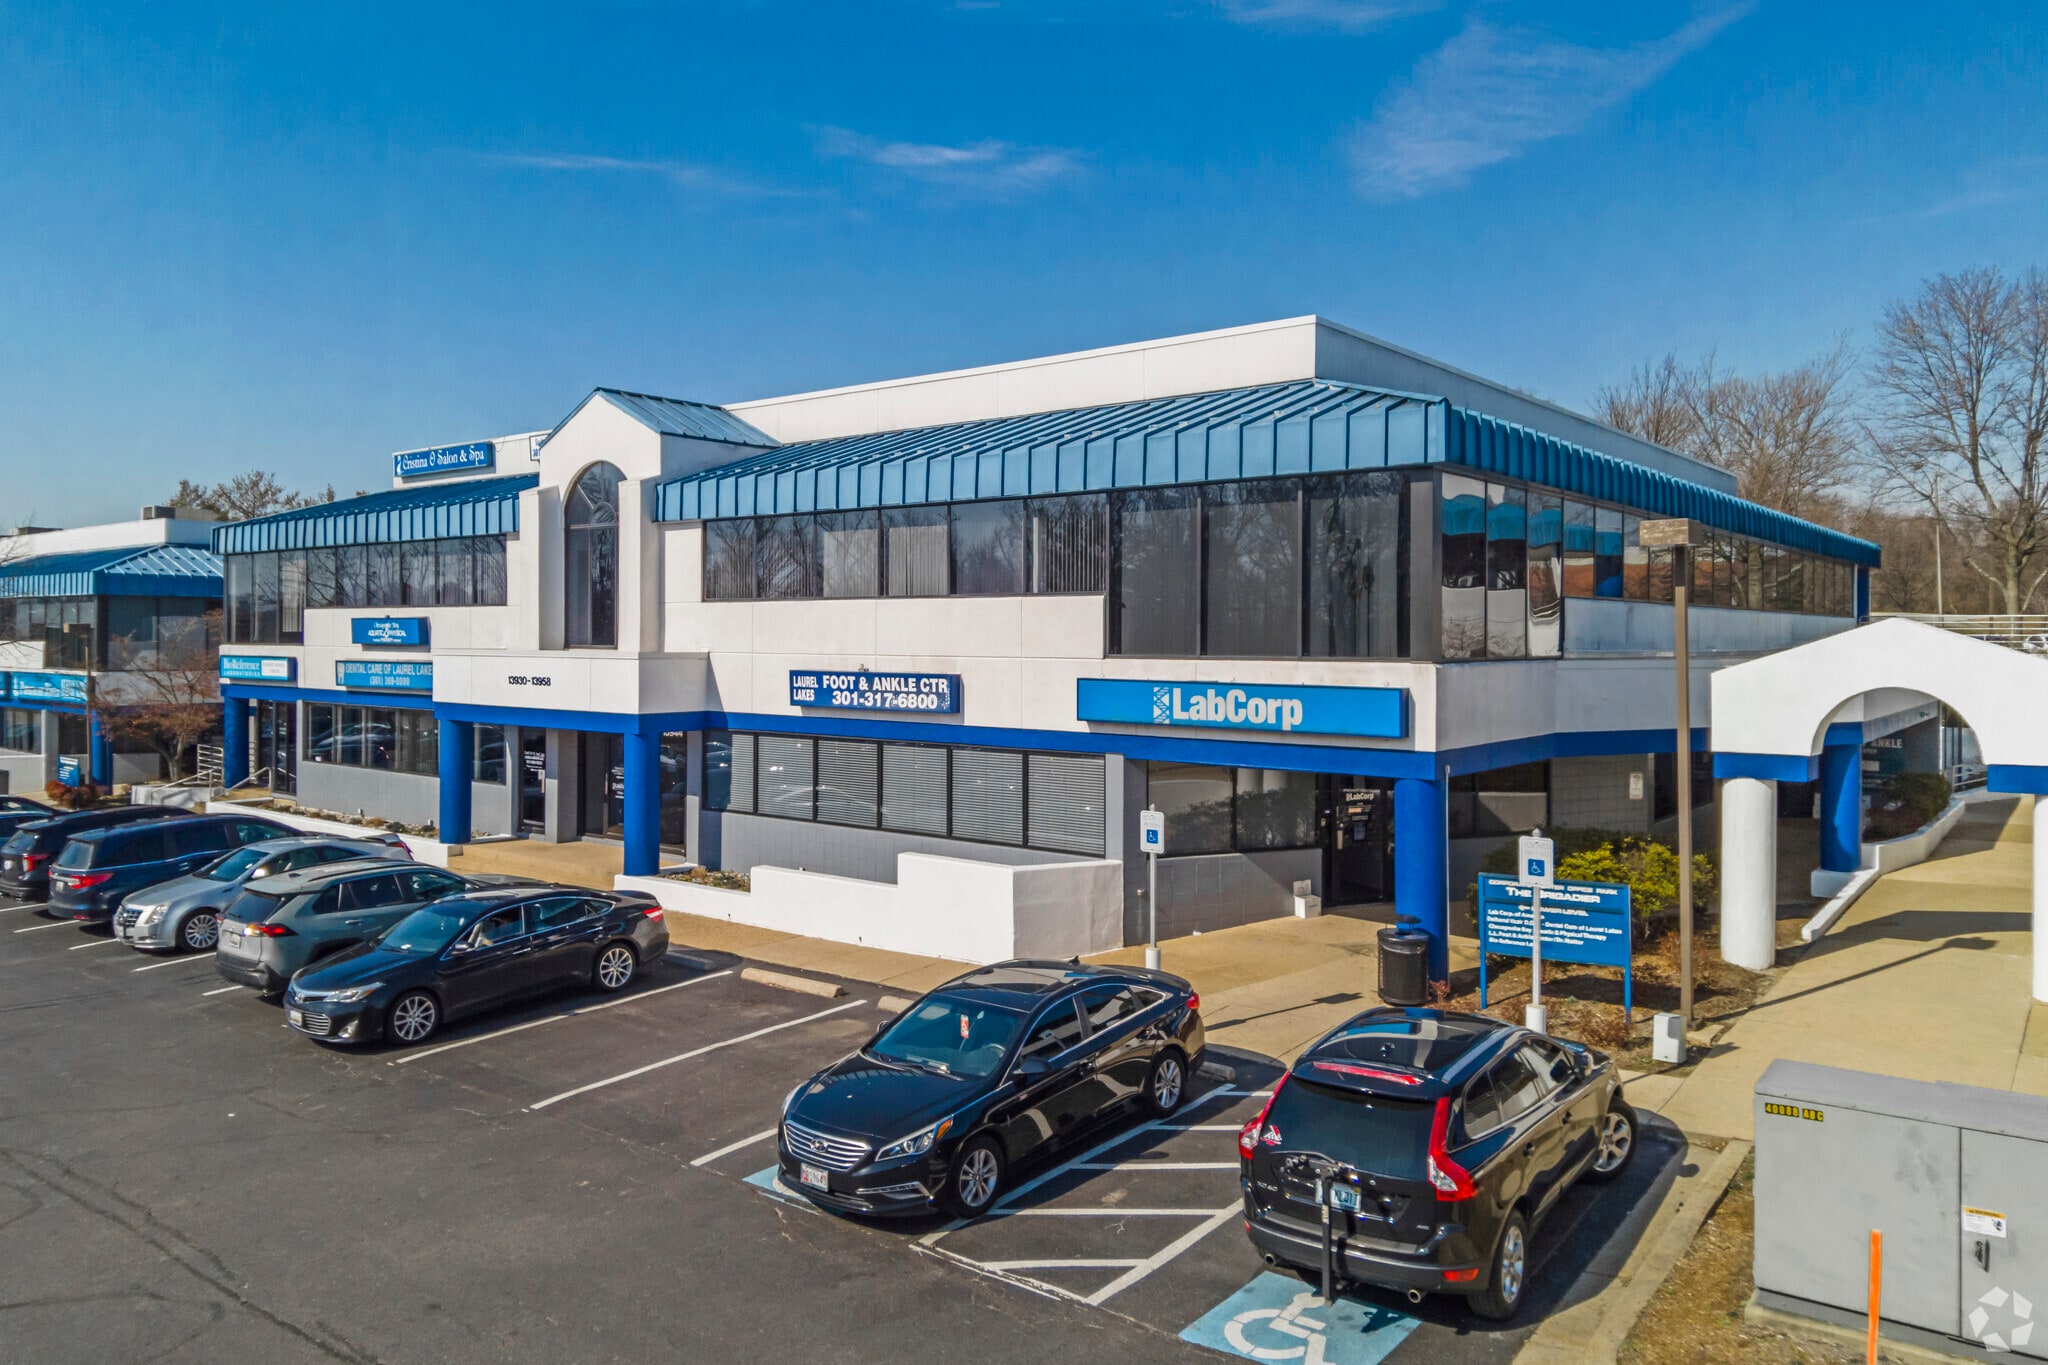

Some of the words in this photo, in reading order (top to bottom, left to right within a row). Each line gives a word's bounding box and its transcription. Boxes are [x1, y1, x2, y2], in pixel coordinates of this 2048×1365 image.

[402, 454, 428, 470] Cristina
[437, 450, 459, 465] Salon
[459, 450, 467, 463] &
[468, 445, 485, 465] Spa
[345, 663, 366, 674] DENTAL
[367, 664, 383, 674] CARE
[383, 664, 391, 674] OF
[392, 663, 415, 675] LAUREL
[416, 664, 433, 675] LAKE
[793, 675, 818, 688] LAUREL
[822, 675, 856, 690] FOOT
[858, 676, 869, 690] &
[872, 676, 917, 692] ANKLE
[919, 677, 949, 693] CTR
[793, 688, 815, 701] LAKES
[832, 690, 938, 710] 301-317-6800
[1172, 687, 1303, 731] LabCorp
[1349, 792, 1375, 801] LabCorp
[1505, 886, 1533, 898] THE
[1545, 921, 1563, 929] Dental
[1521, 926, 1532, 934] Bay
[1560, 930, 1583, 938] Physical
[1583, 932, 1607, 941] Therapy
[1765, 1103, 1799, 1117] 40088
